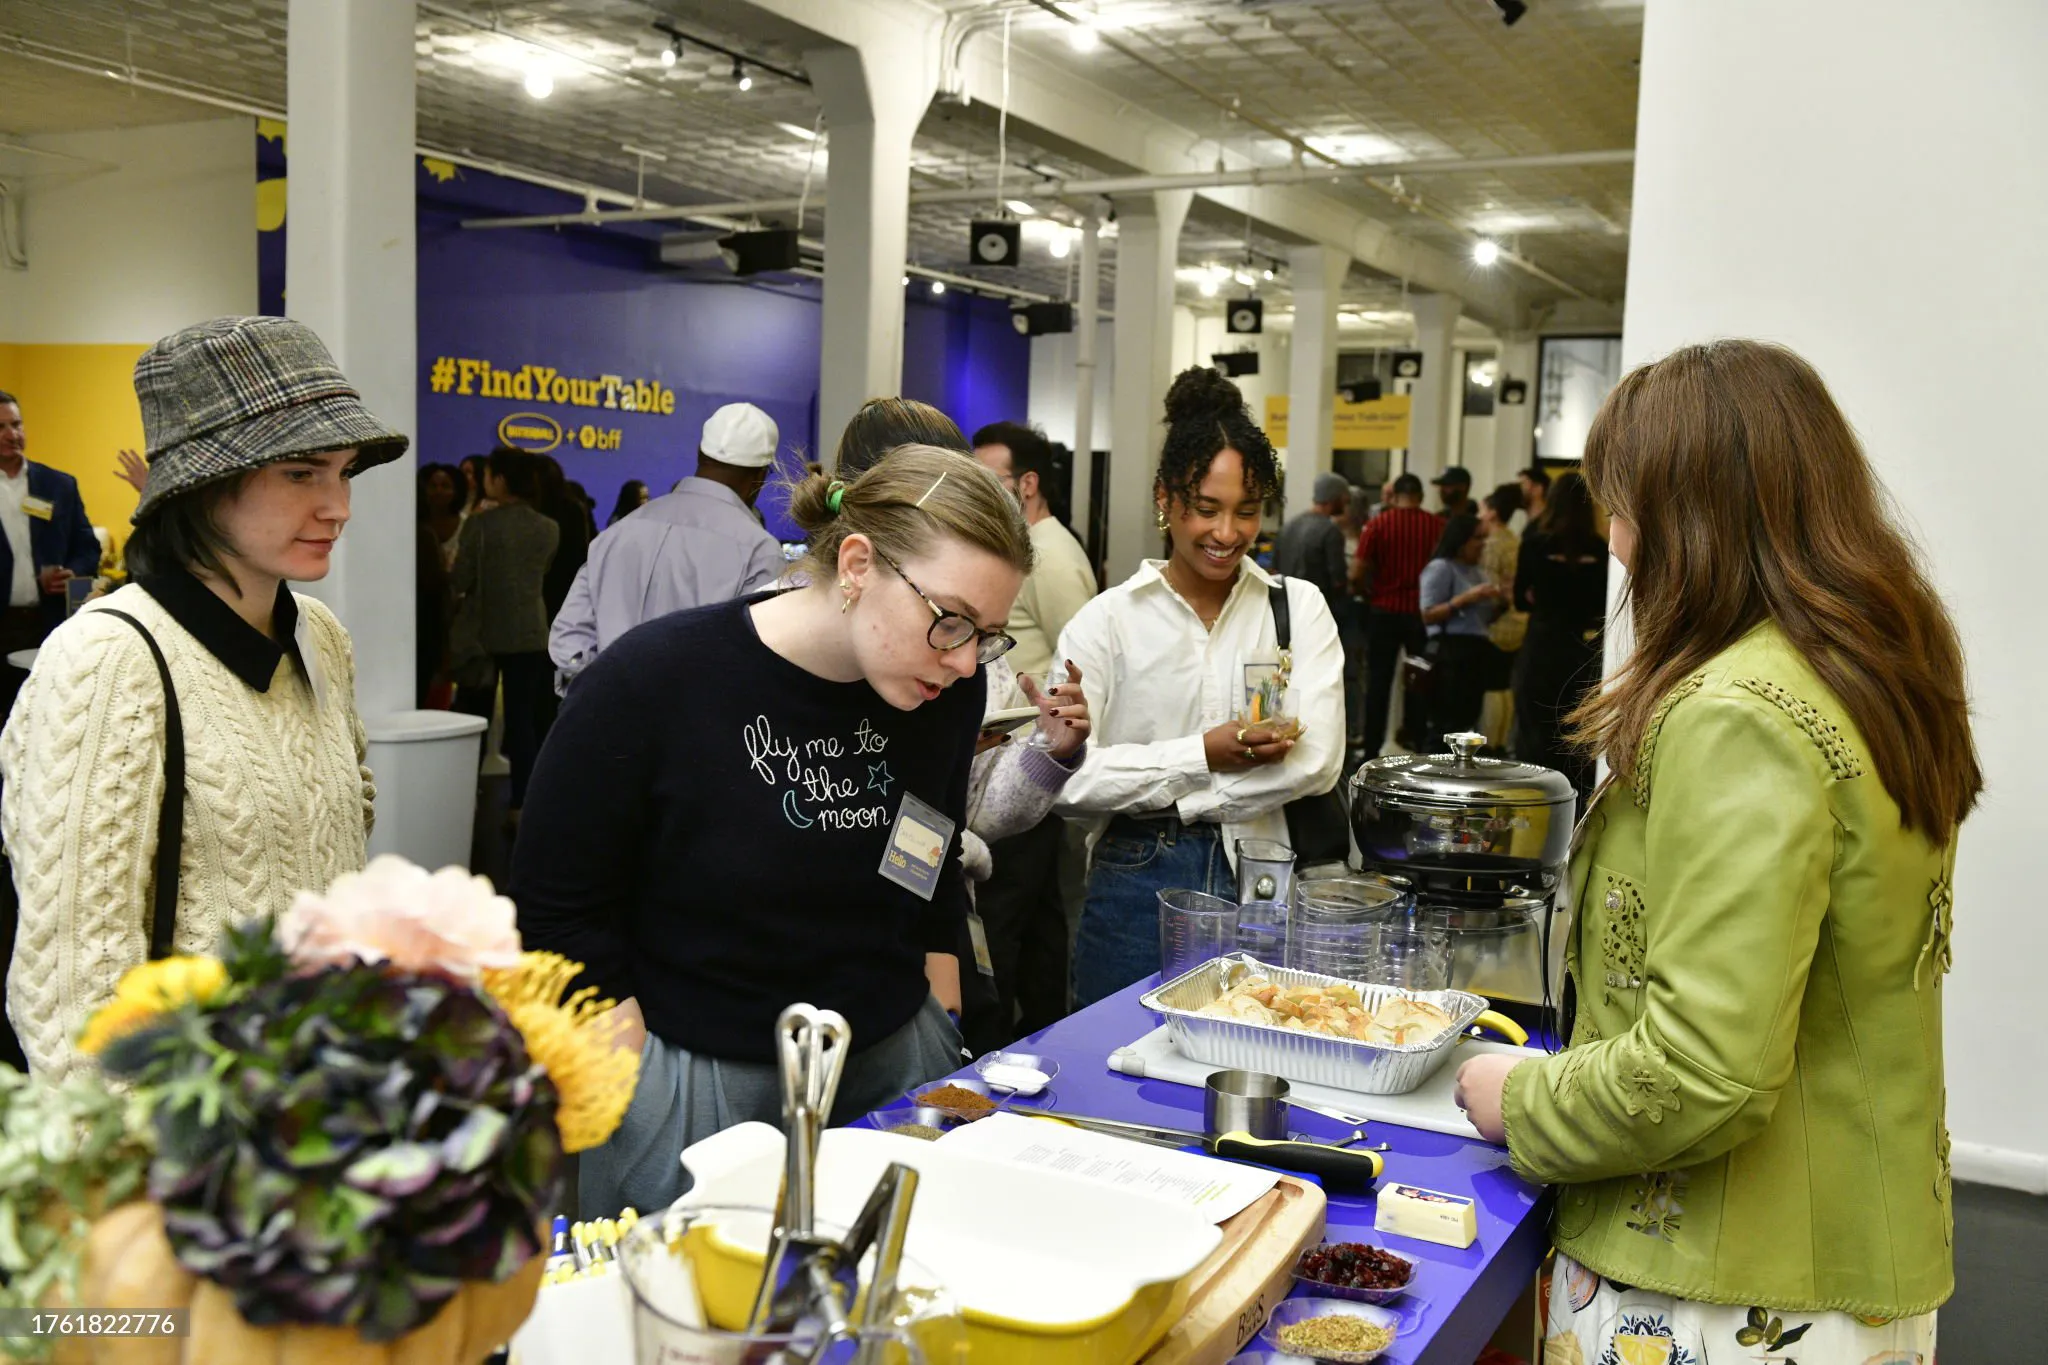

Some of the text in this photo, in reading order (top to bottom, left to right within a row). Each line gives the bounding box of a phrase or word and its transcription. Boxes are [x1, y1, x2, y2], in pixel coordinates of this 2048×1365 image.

[430, 356, 676, 416] #FindYourTable
[597, 427, 623, 450] bff
[743, 714, 889, 786] fly me to
[801, 765, 860, 803] the
[817, 805, 891, 832] moon
